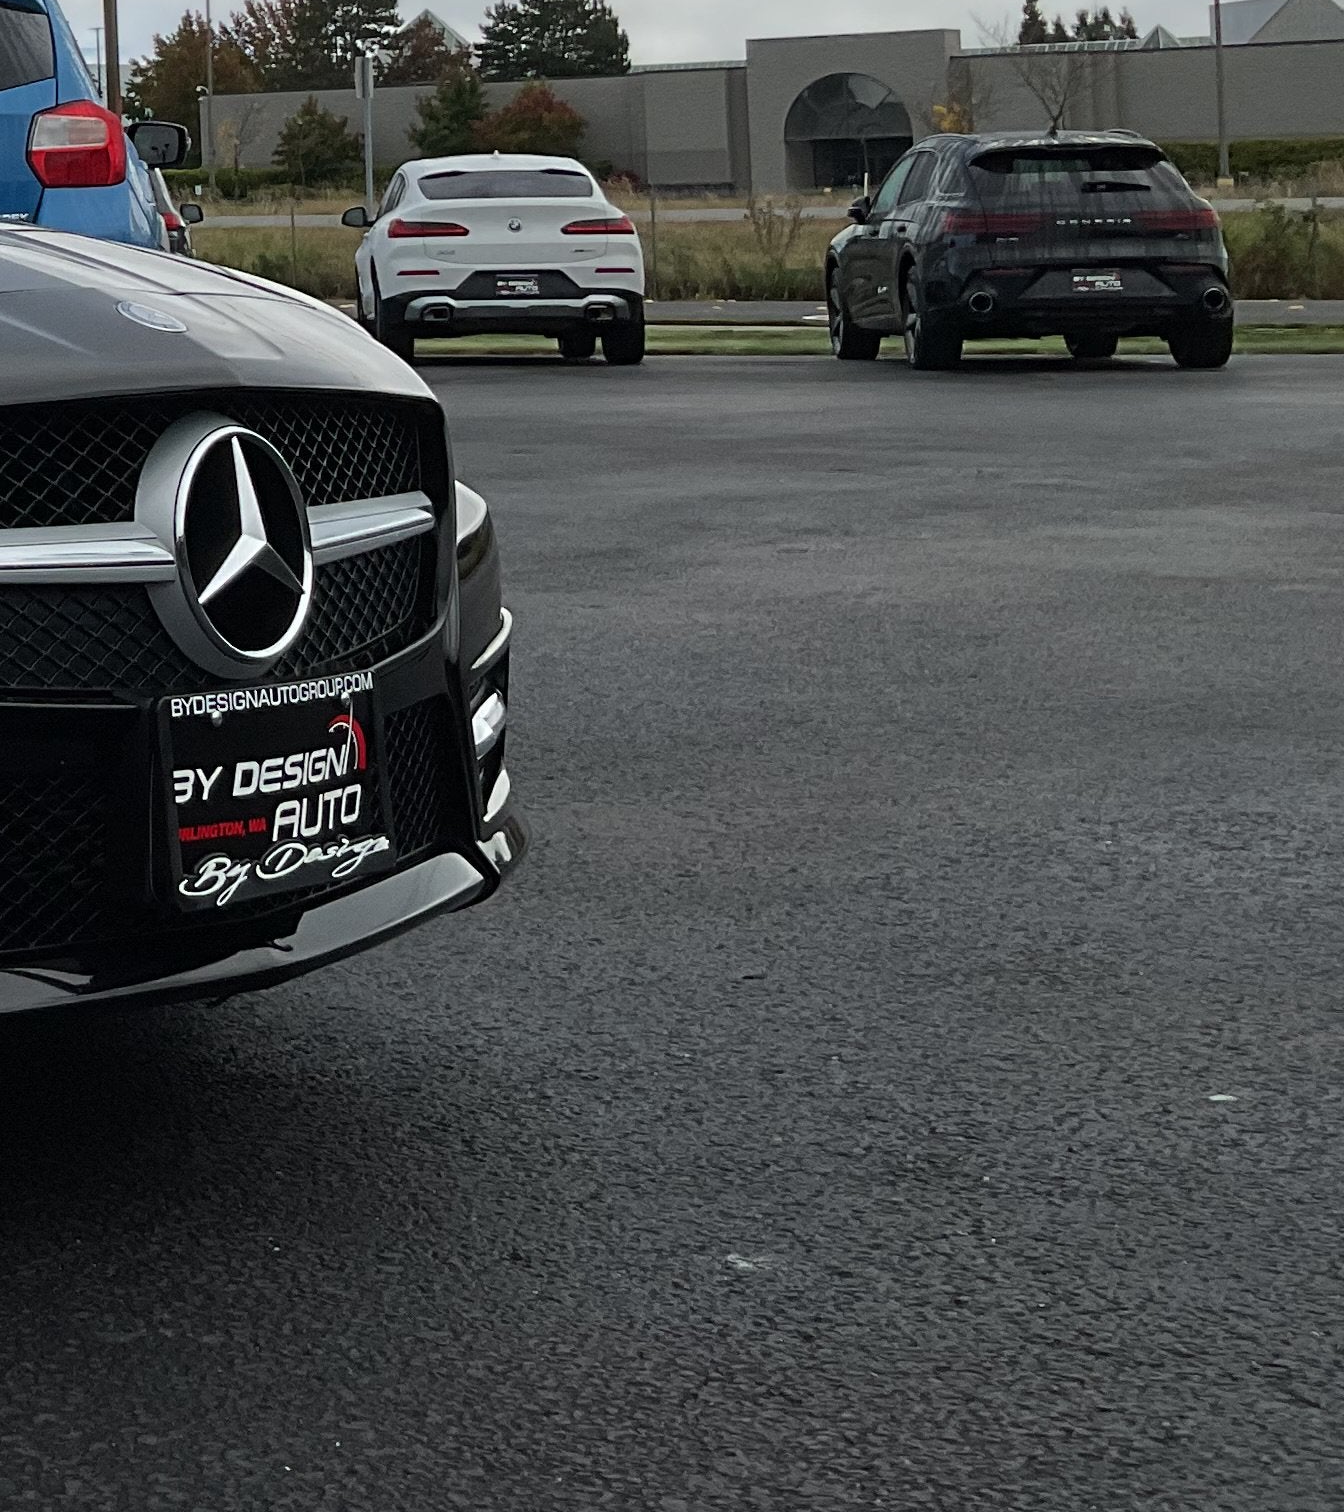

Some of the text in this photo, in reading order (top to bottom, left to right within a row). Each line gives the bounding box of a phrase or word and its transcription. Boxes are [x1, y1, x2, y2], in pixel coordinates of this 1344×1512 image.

[171, 673, 373, 717] BYDESIGNAUTOGROUP.COM
[173, 744, 347, 804] BY DESIGN
[272, 784, 361, 842] AUTO
[179, 836, 390, 906] By Design
